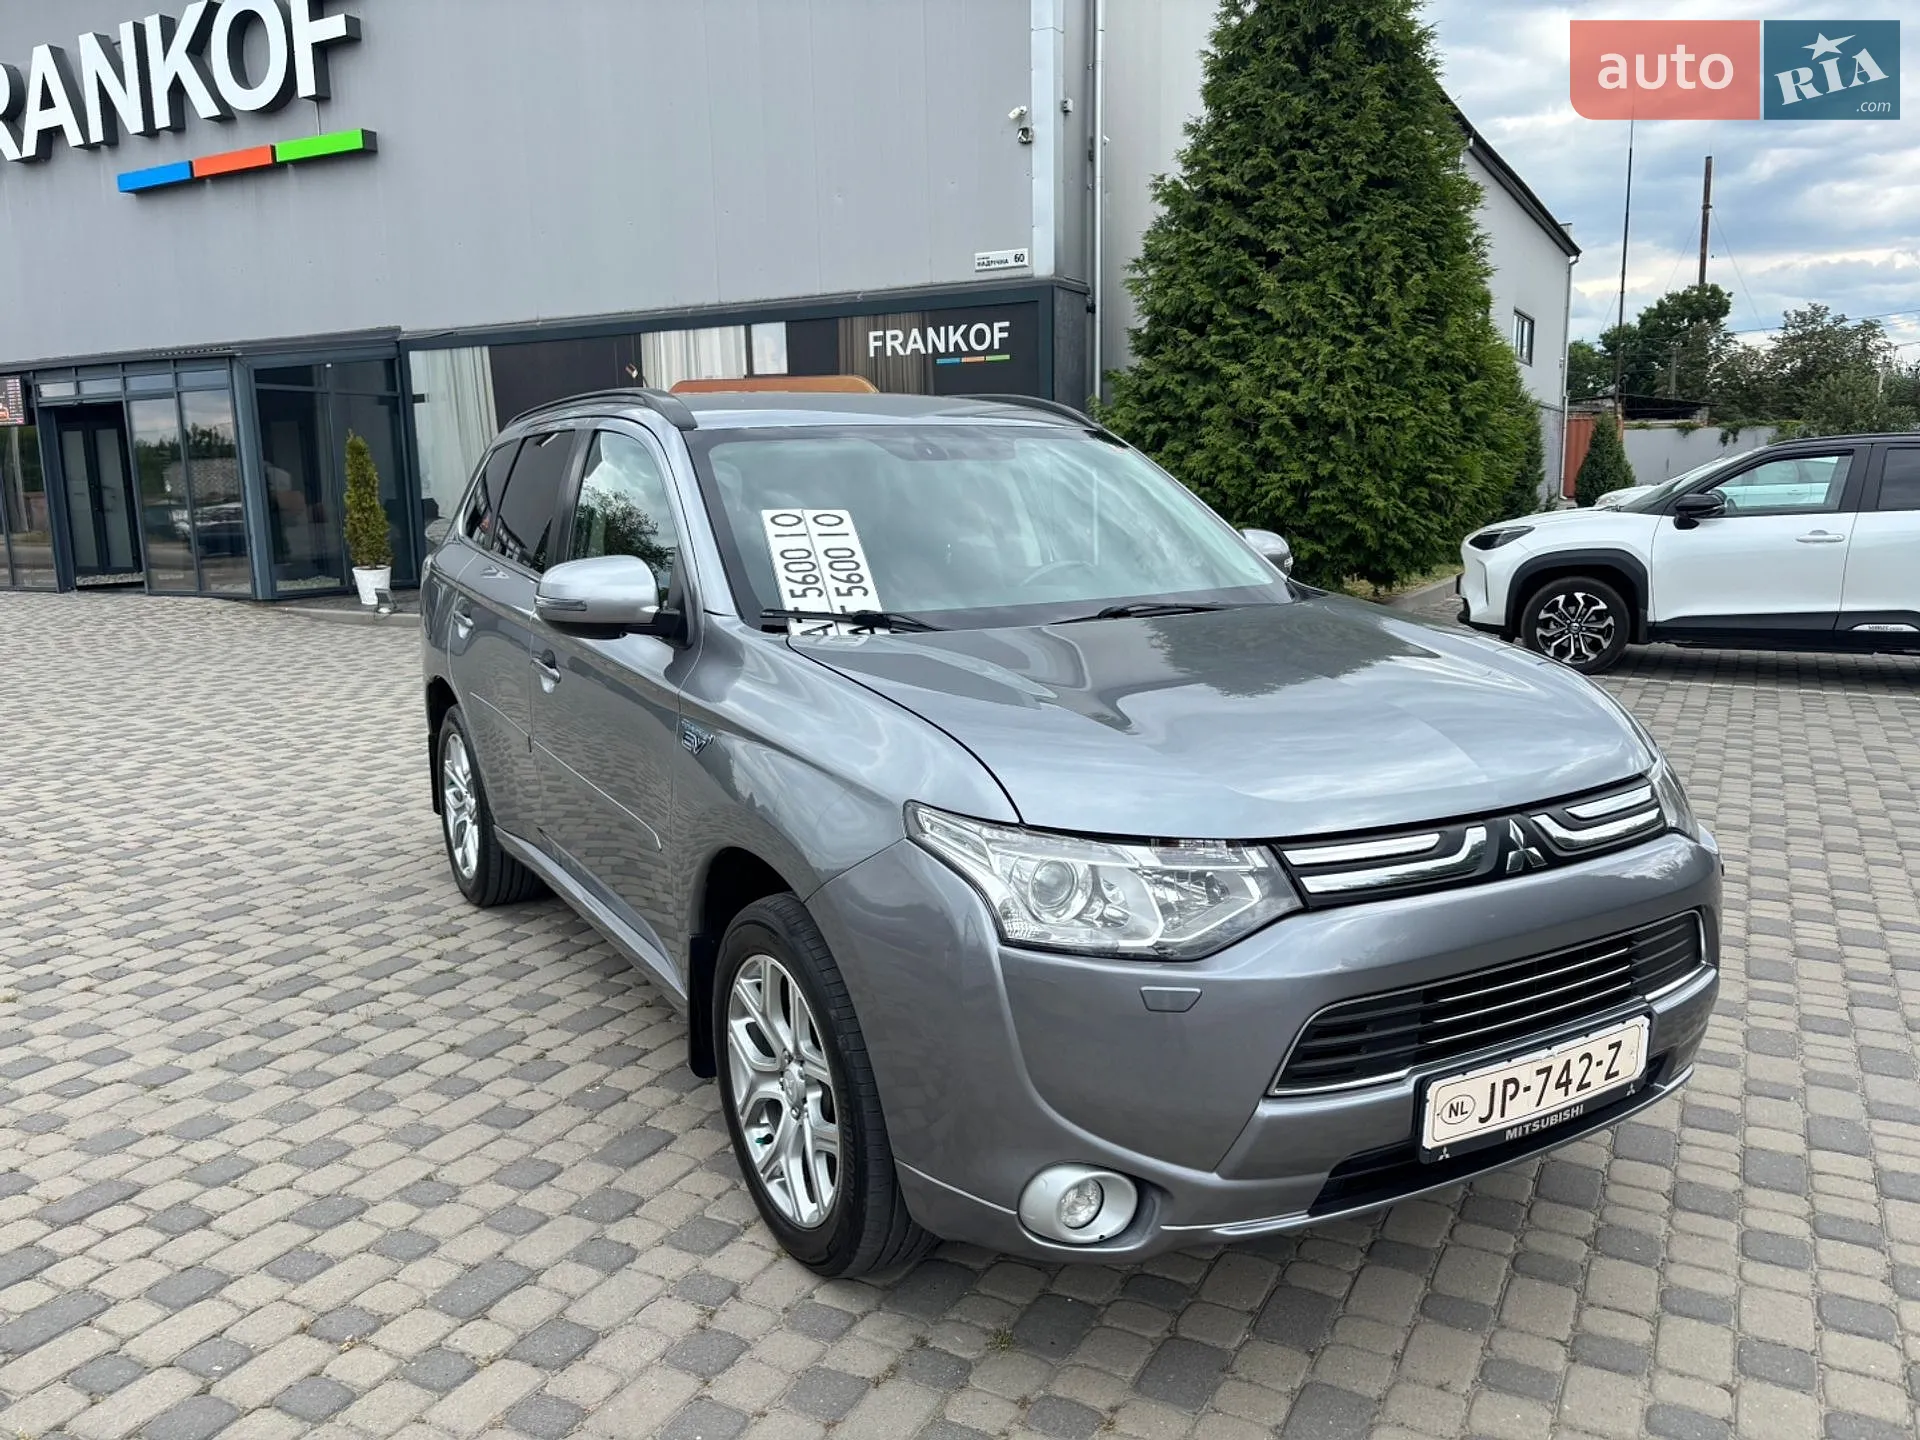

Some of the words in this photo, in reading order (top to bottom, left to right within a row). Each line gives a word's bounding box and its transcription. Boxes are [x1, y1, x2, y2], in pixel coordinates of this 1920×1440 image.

[1014, 253, 1025, 263] 60
[868, 321, 1010, 358] FRANKOF
[780, 548, 824, 598] 5600
[824, 547, 869, 597] 5600
[1449, 1099, 1469, 1119] NL
[1478, 1040, 1623, 1124] JP-742-Z
[1505, 1104, 1584, 1141] MITSUBISHI
